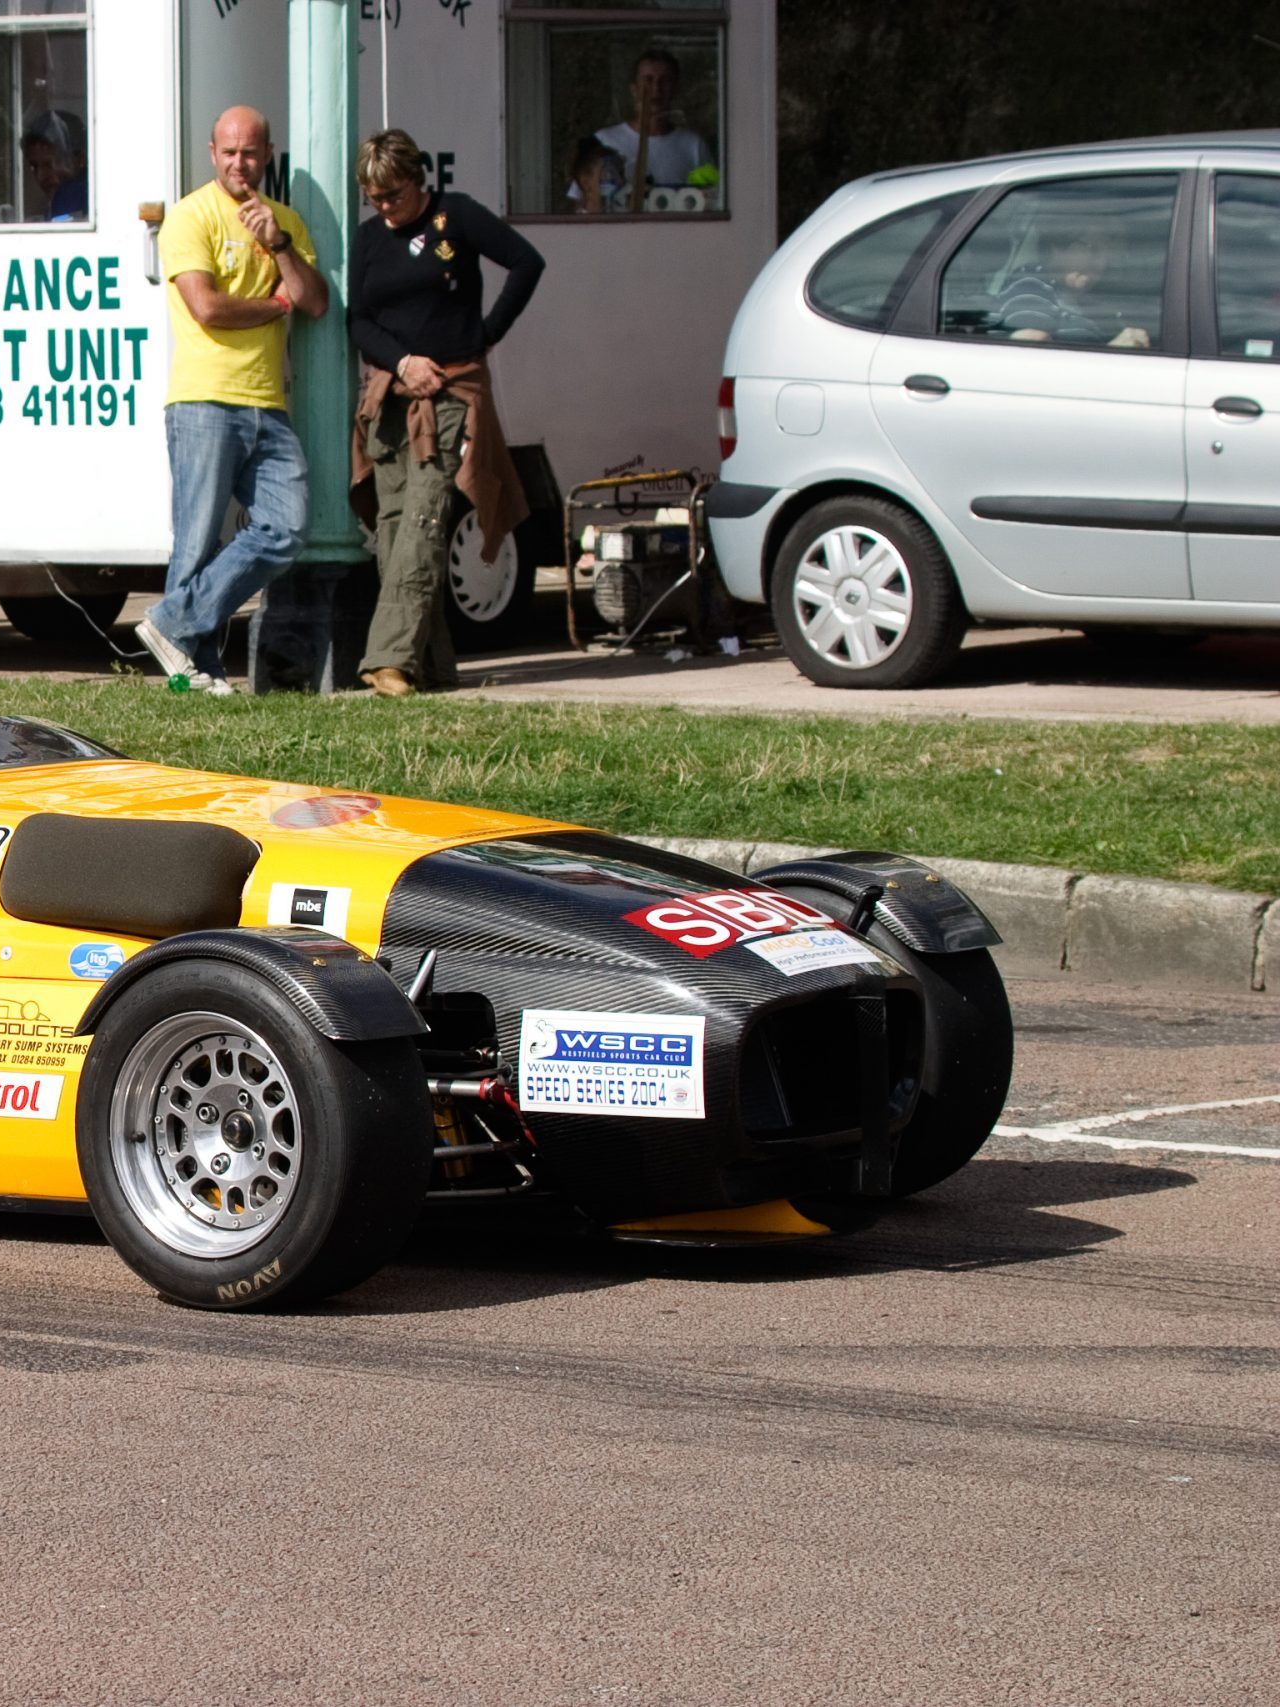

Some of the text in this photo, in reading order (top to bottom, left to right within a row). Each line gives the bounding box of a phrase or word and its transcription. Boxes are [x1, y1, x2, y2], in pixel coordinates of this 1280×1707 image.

[47, 328, 149, 382] UNIT
[23, 384, 135, 427] 411191
[295, 900, 322, 913] mbe
[646, 891, 835, 946] SBD
[14, 1040, 42, 1052] SUMP
[45, 1042, 88, 1055] SYSTEMS
[561, 1032, 687, 1053] WSCC
[11, 1054, 34, 1065] 01284
[36, 1056, 66, 1067] 850959
[561, 1050, 685, 1062] WESTFIELD SPORTS CAR CLUB
[527, 1063, 691, 1079] WWW.WSCC.CO.UK
[527, 1076, 666, 1106] SPEED SERIES 2004
[217, 1257, 281, 1299] AVON
